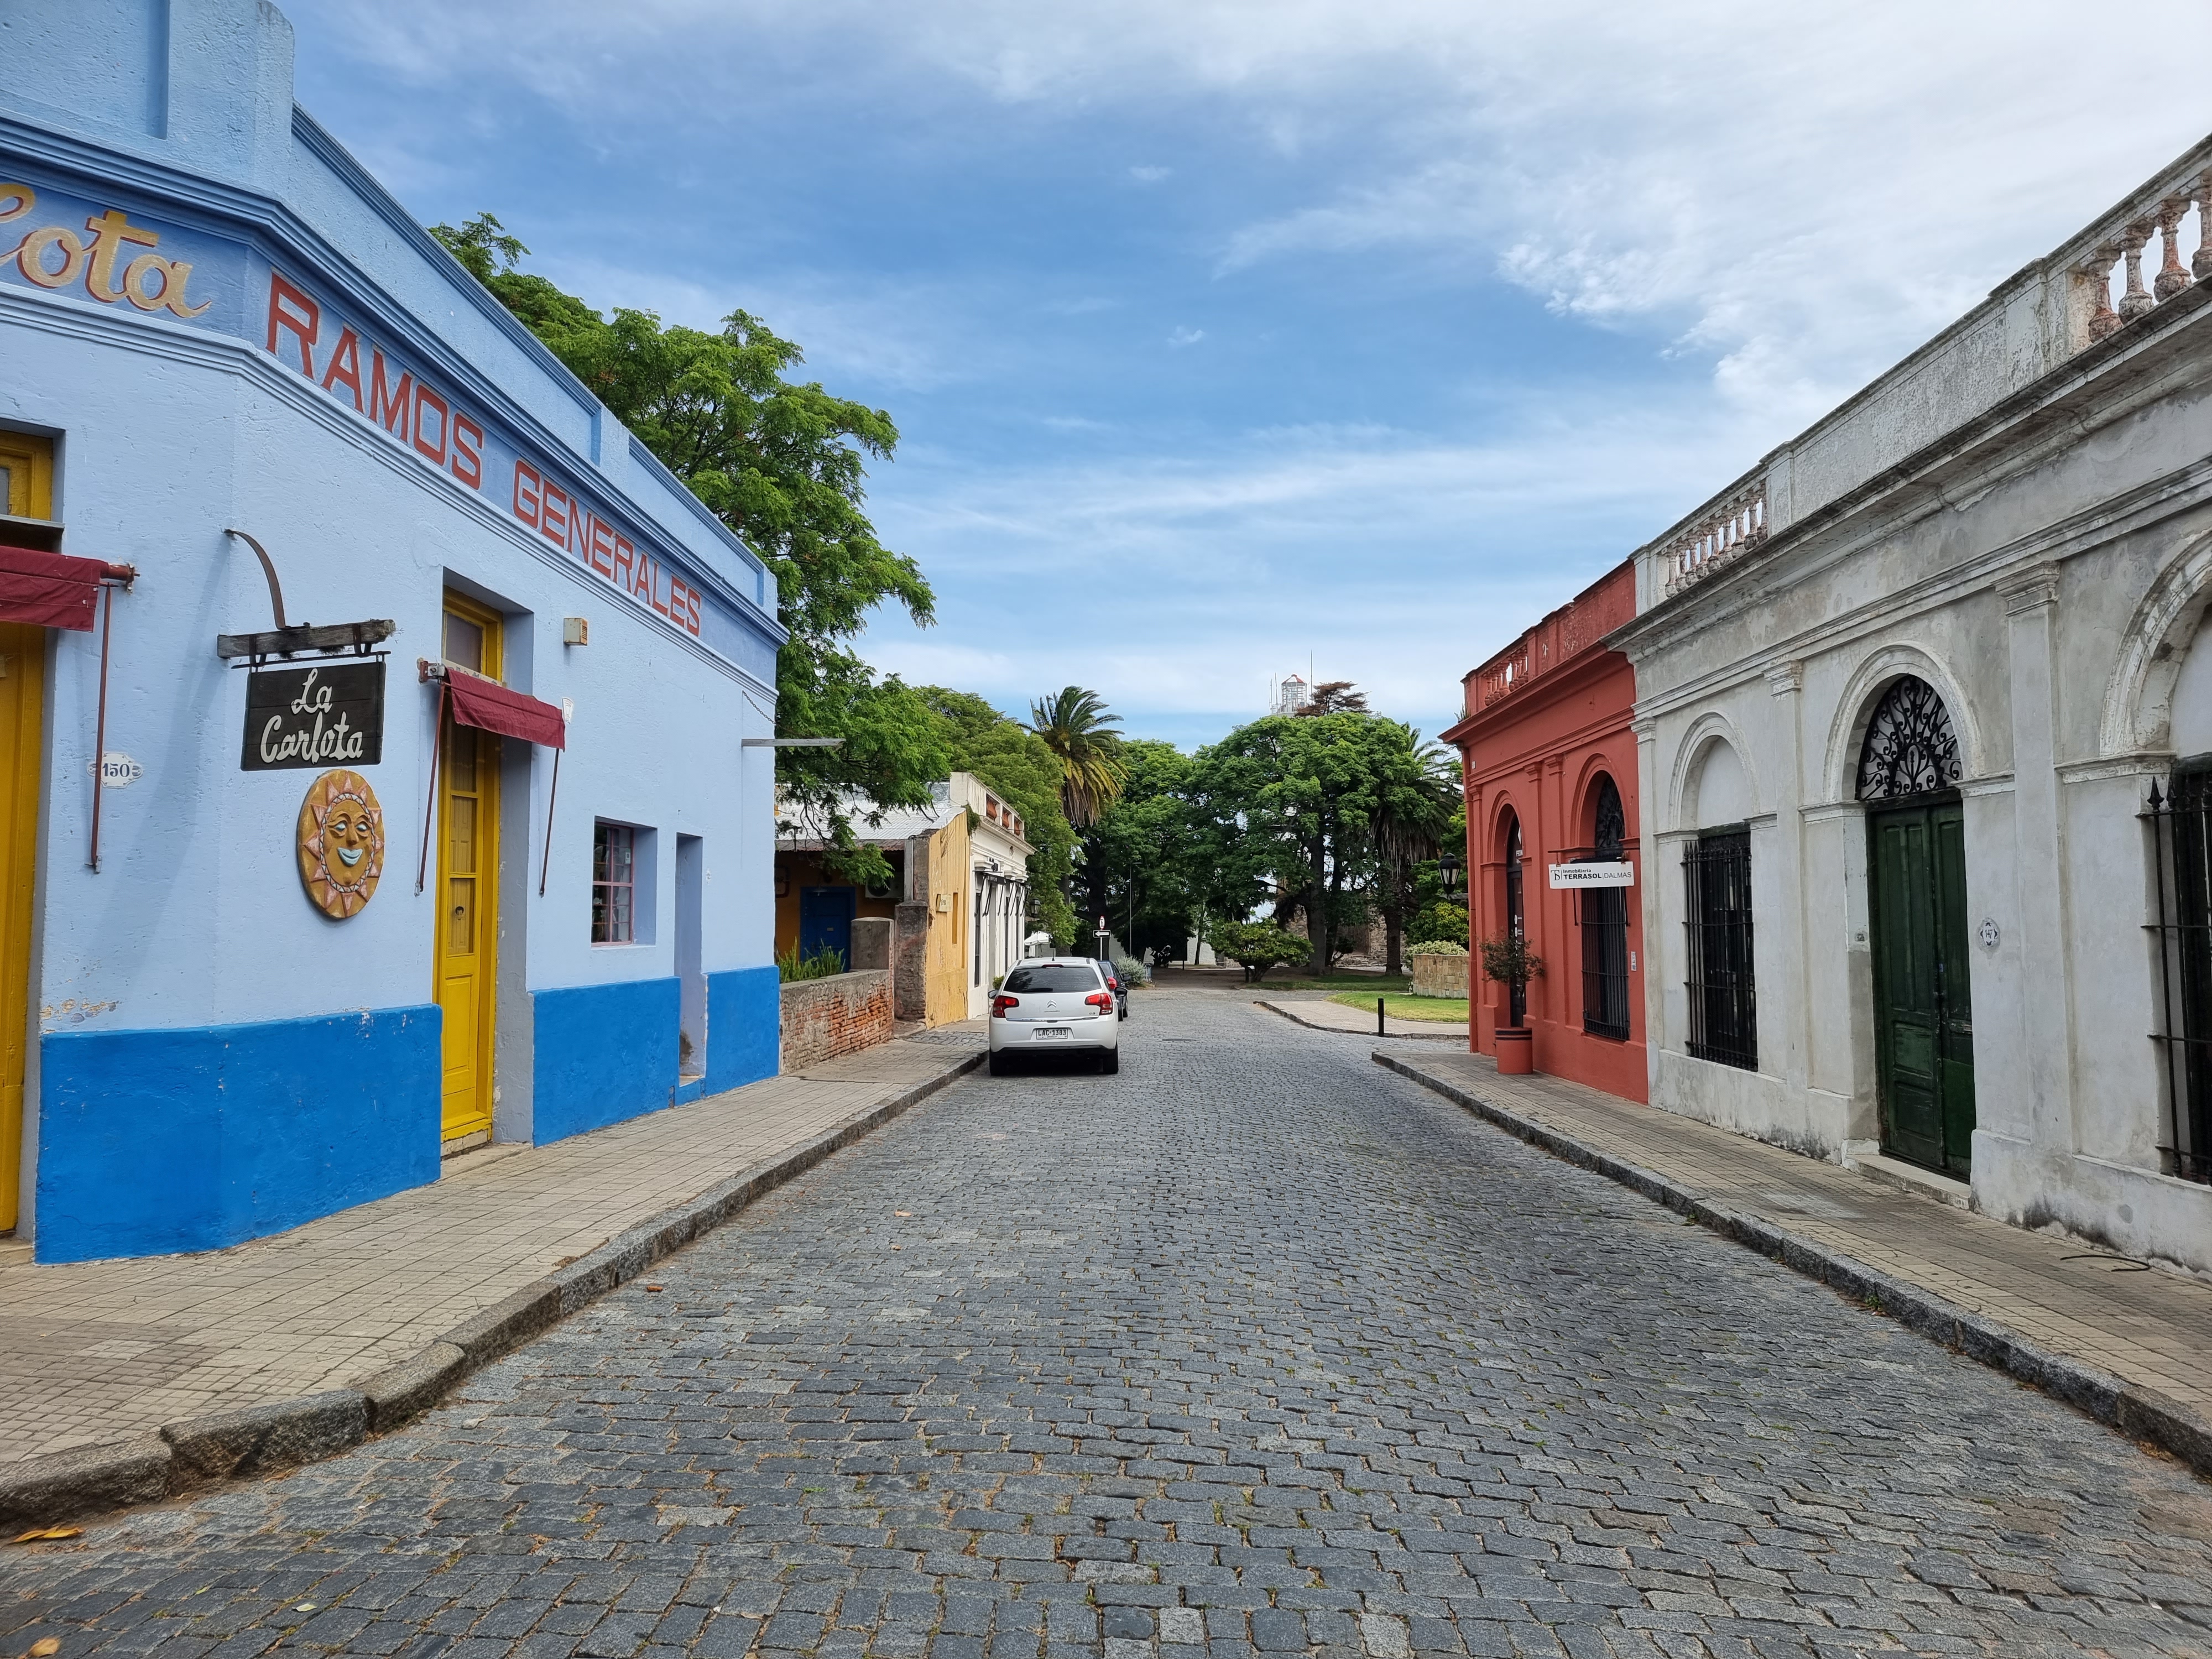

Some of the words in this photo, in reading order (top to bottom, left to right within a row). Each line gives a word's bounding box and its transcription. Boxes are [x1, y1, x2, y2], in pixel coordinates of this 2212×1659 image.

[266, 271, 483, 491] RAMOS
[513, 460, 701, 637] GENERALES
[291, 668, 332, 714] La
[260, 711, 363, 764] Carlota
[102, 763, 130, 778] 150
